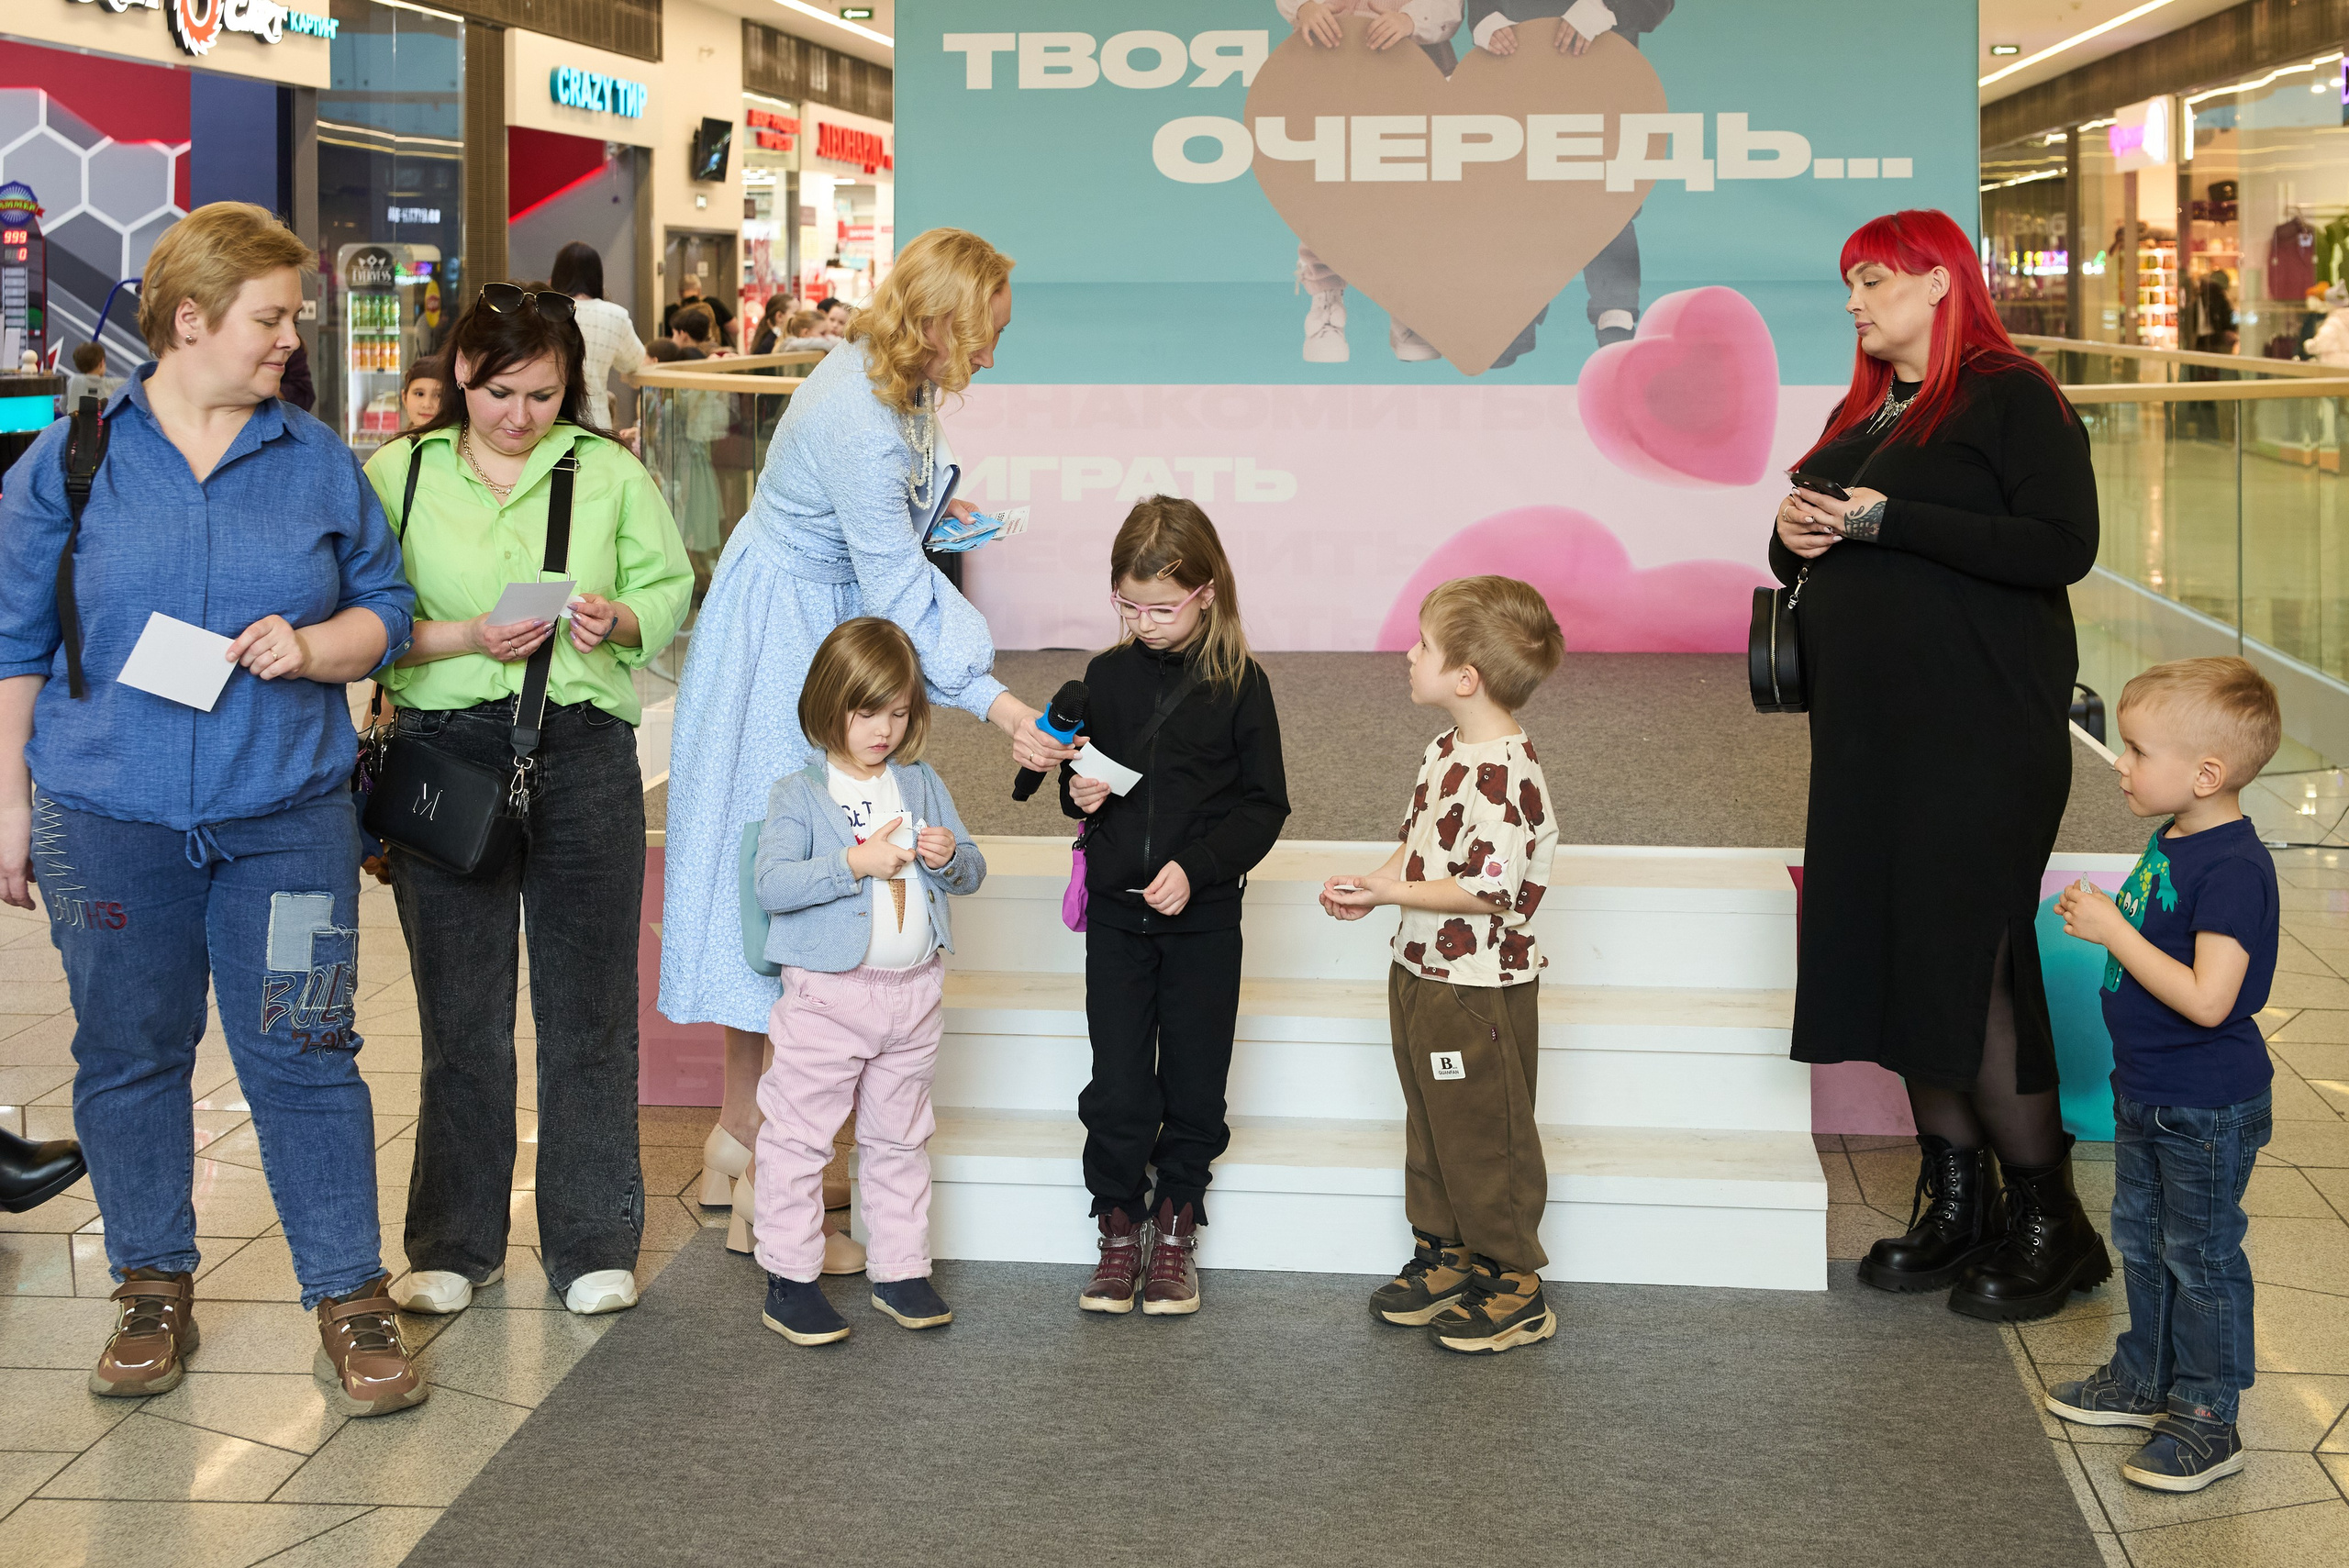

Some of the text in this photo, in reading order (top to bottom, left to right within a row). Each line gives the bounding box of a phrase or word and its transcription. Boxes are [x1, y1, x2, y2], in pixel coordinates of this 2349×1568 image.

[290, 11, 340, 39] КАРТИНГ
[942, 30, 1269, 90] ТВОЯ
[554, 64, 648, 119] CRAZY ТИР
[1152, 112, 1913, 192] ОЧЕРЕДЬ...
[4, 230, 28, 244] 999
[952, 456, 1298, 503] ИГРАТЬ
[1440, 1057, 1453, 1070] B
